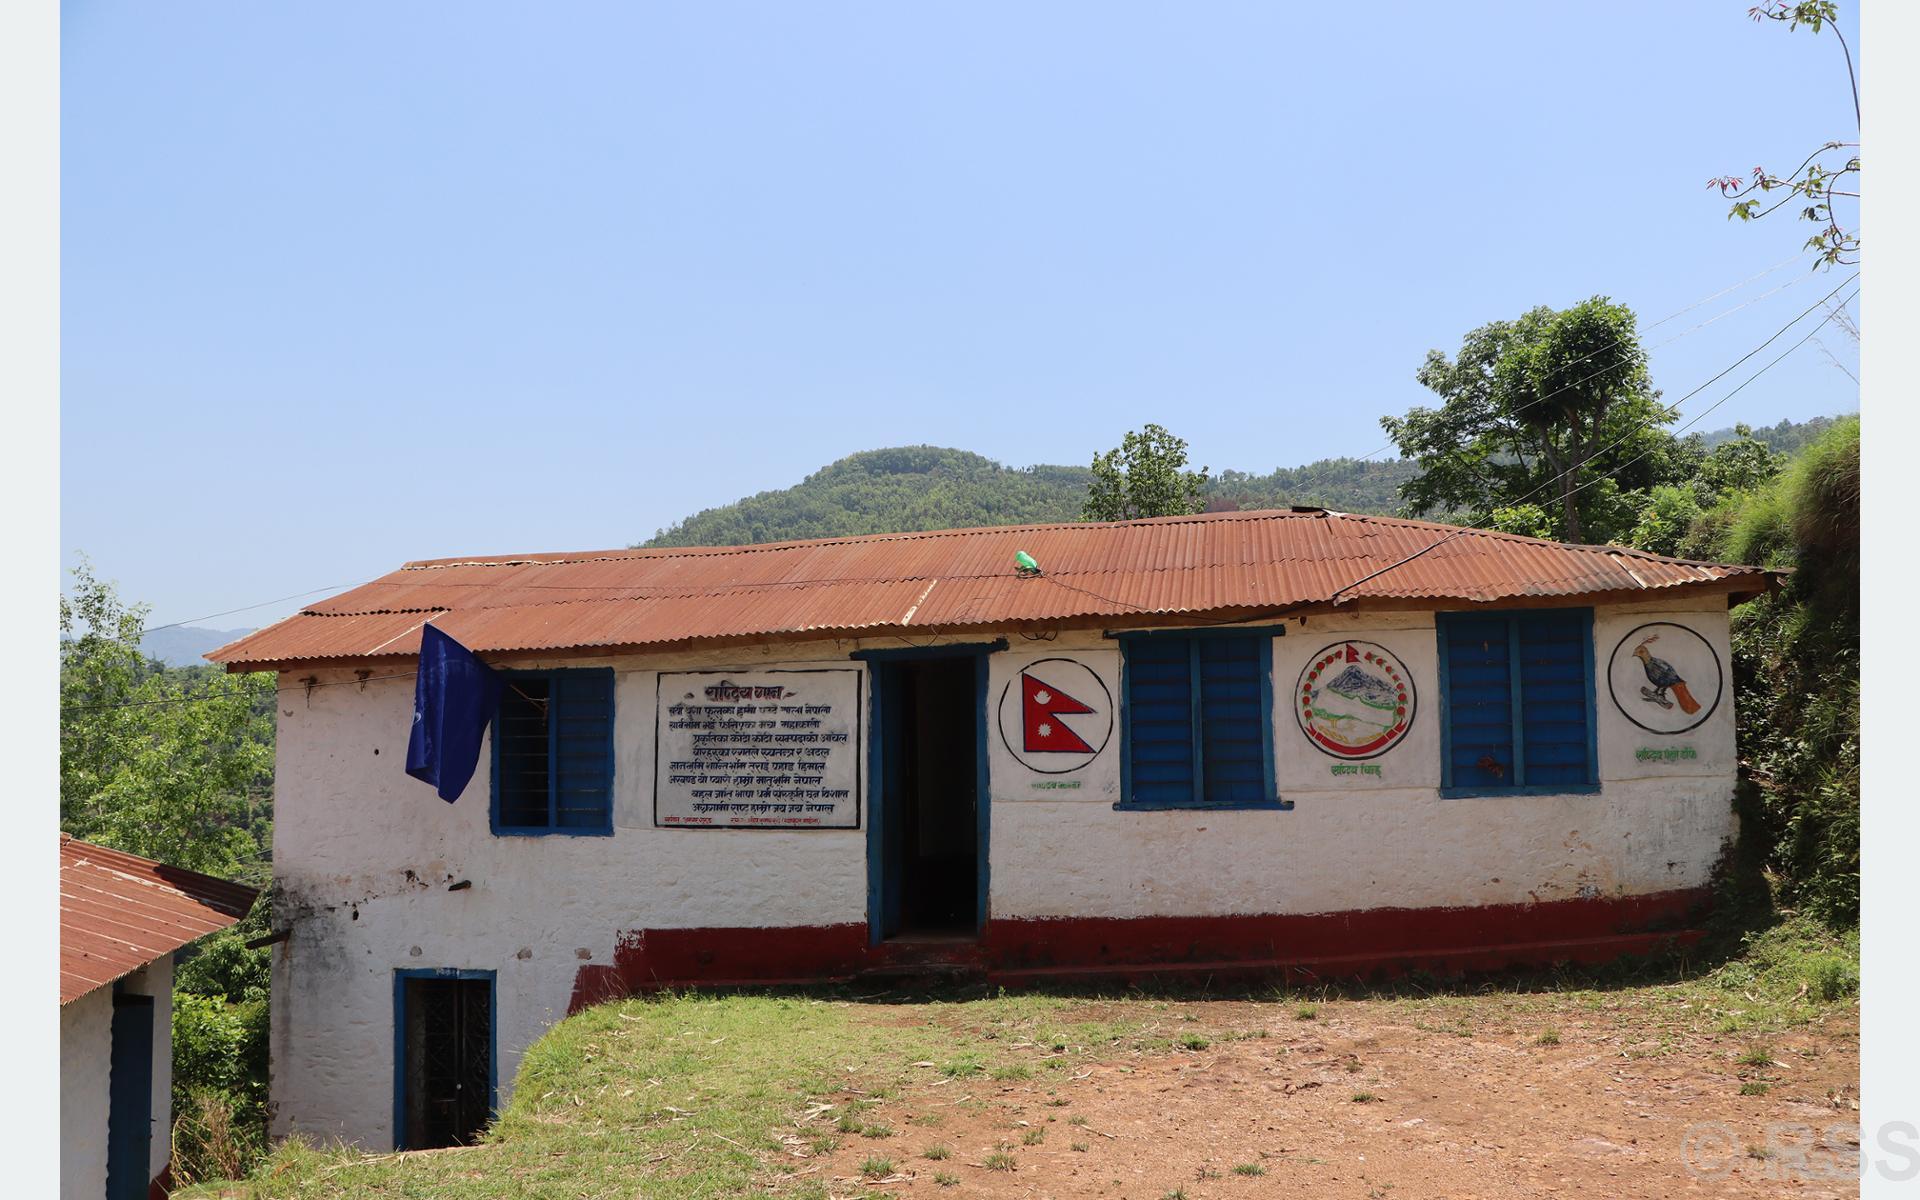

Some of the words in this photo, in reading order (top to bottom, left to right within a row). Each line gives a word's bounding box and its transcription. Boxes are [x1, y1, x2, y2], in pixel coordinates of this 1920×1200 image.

[804, 747, 831, 758] अटल
[797, 758, 826, 774] हिमाल
[793, 773, 824, 787] नेपाल
[772, 804, 787, 813] जय
[788, 804, 804, 813] जय
[805, 800, 835, 815] नेपाल
